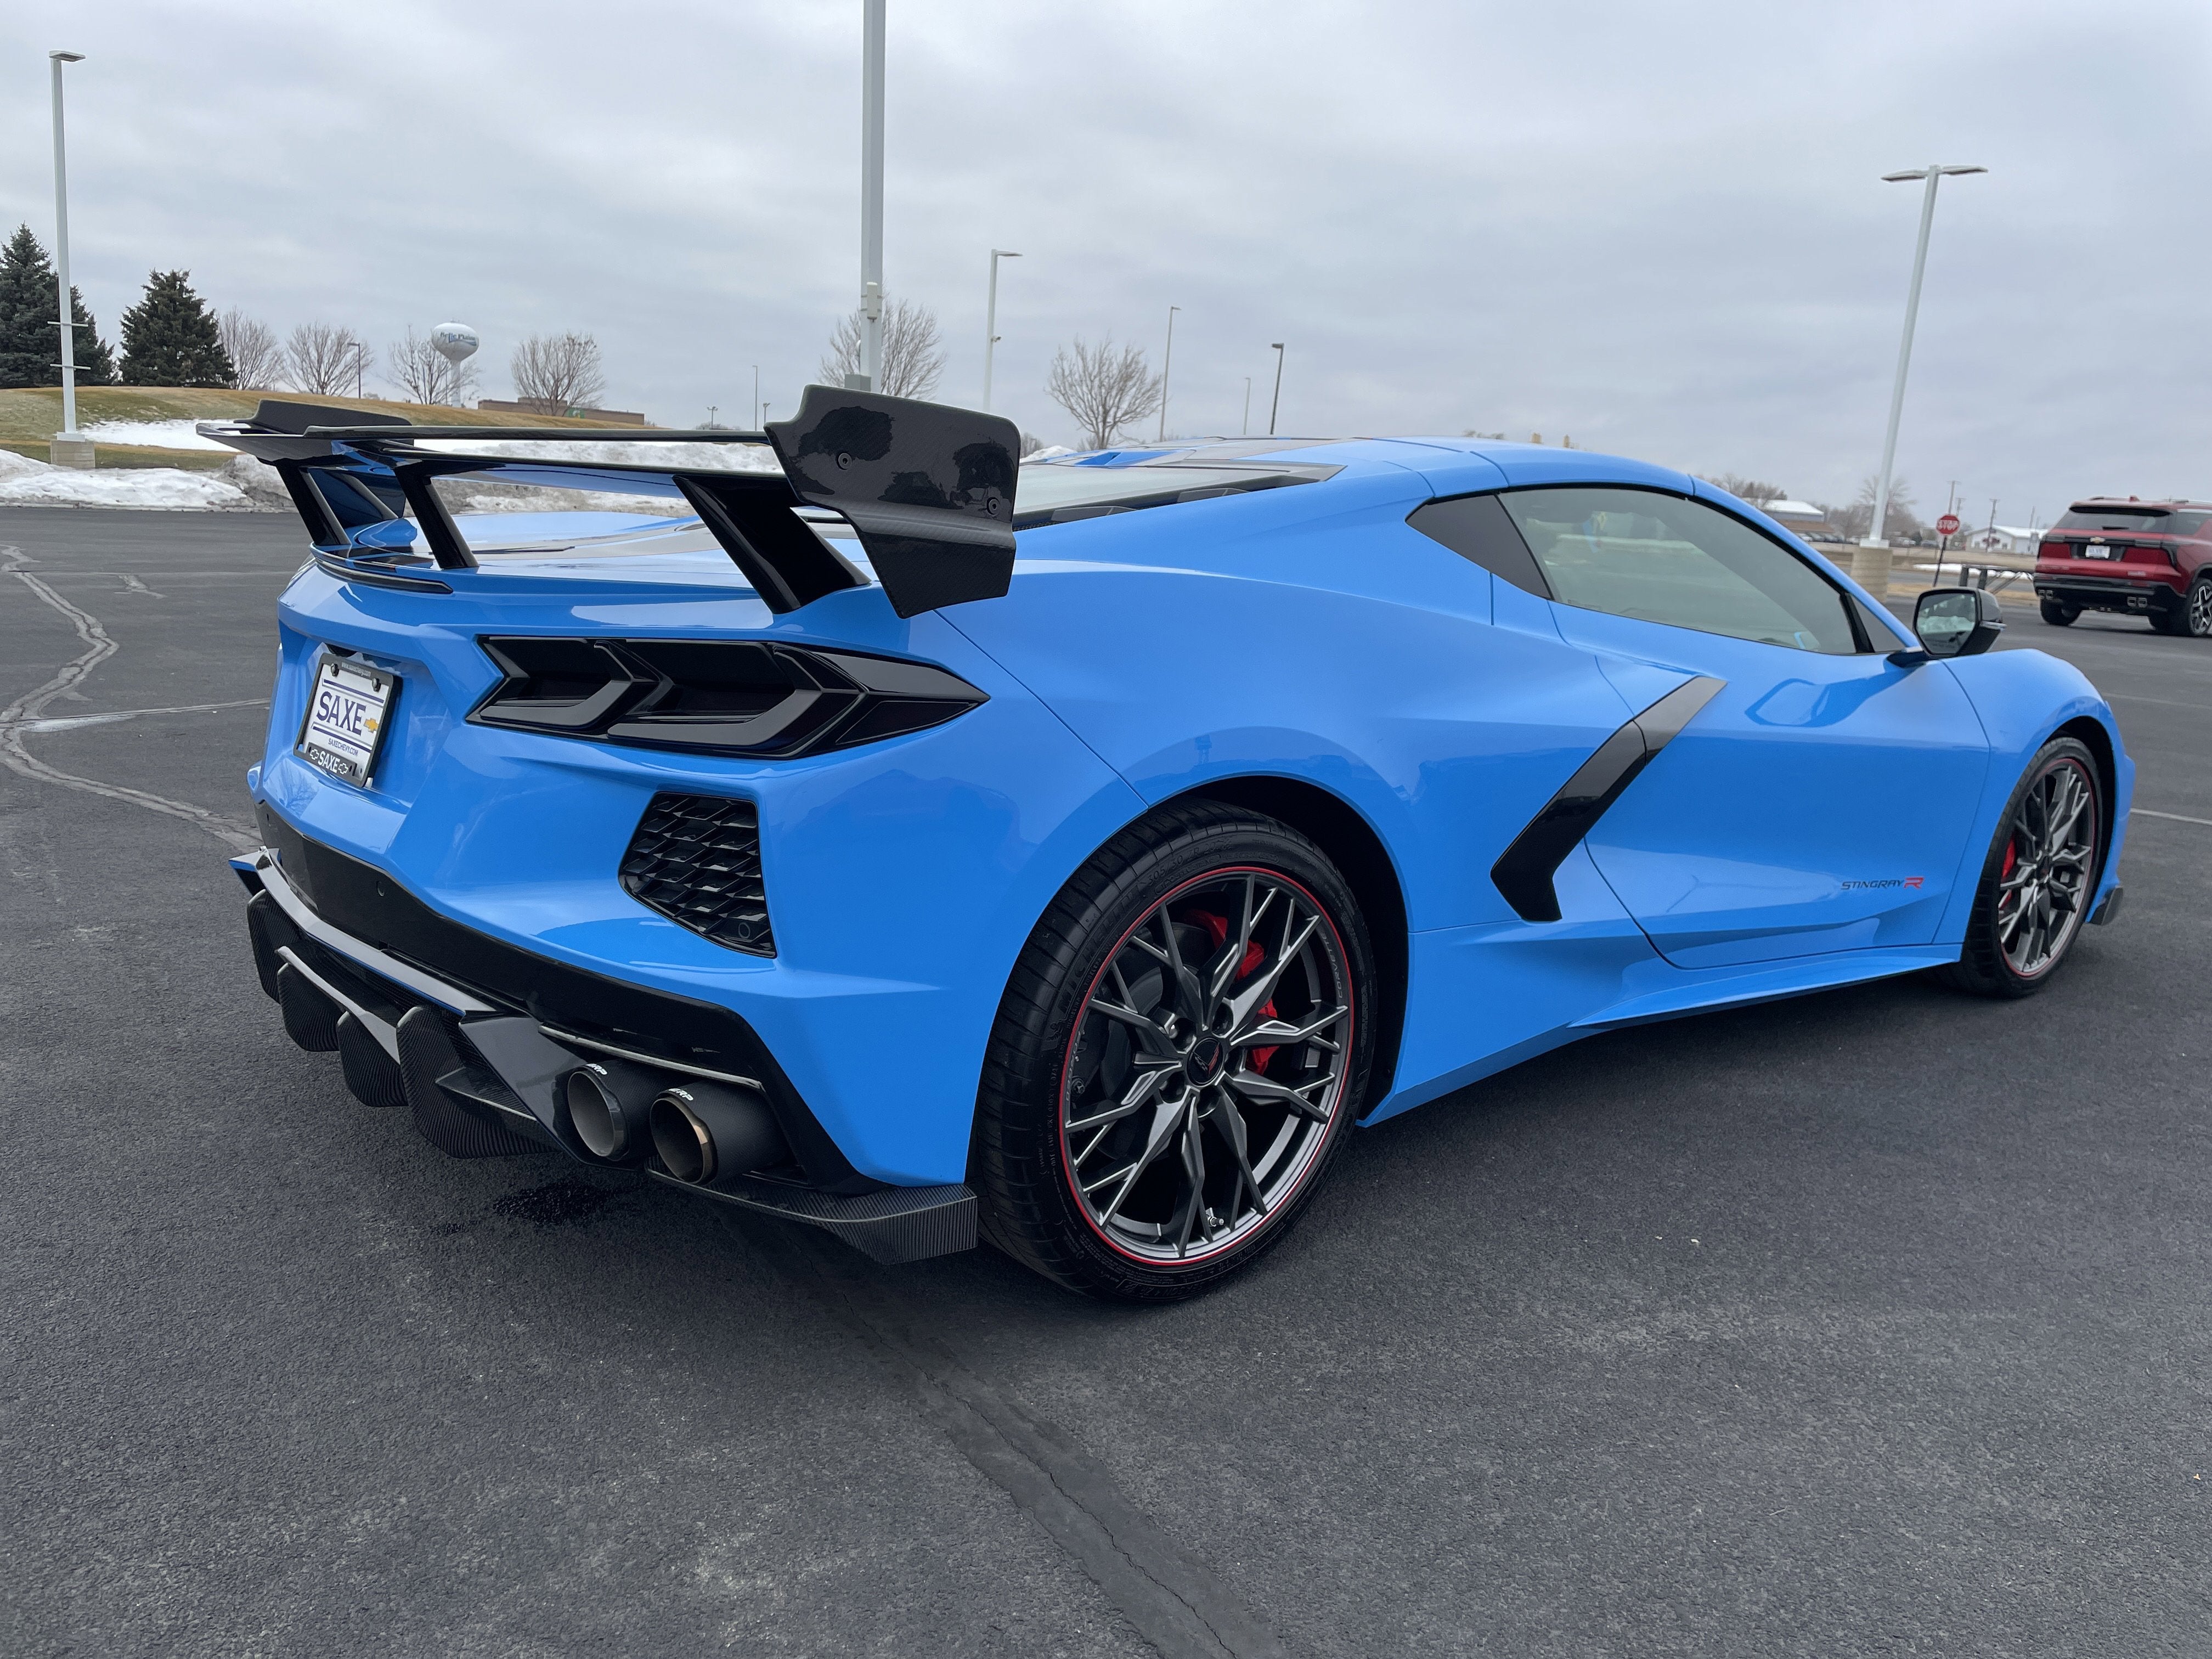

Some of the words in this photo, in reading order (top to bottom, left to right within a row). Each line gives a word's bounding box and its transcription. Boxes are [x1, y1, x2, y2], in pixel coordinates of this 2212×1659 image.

[1938, 520, 1958, 531] STOP
[316, 691, 366, 736] SAXE
[328, 738, 358, 757] SAXECHEVY.COM
[318, 751, 341, 774] SAXE
[1841, 879, 1904, 890] STINGRAY
[1321, 932, 1342, 998] CORVETTE
[1066, 1030, 1081, 1102] FORGED
